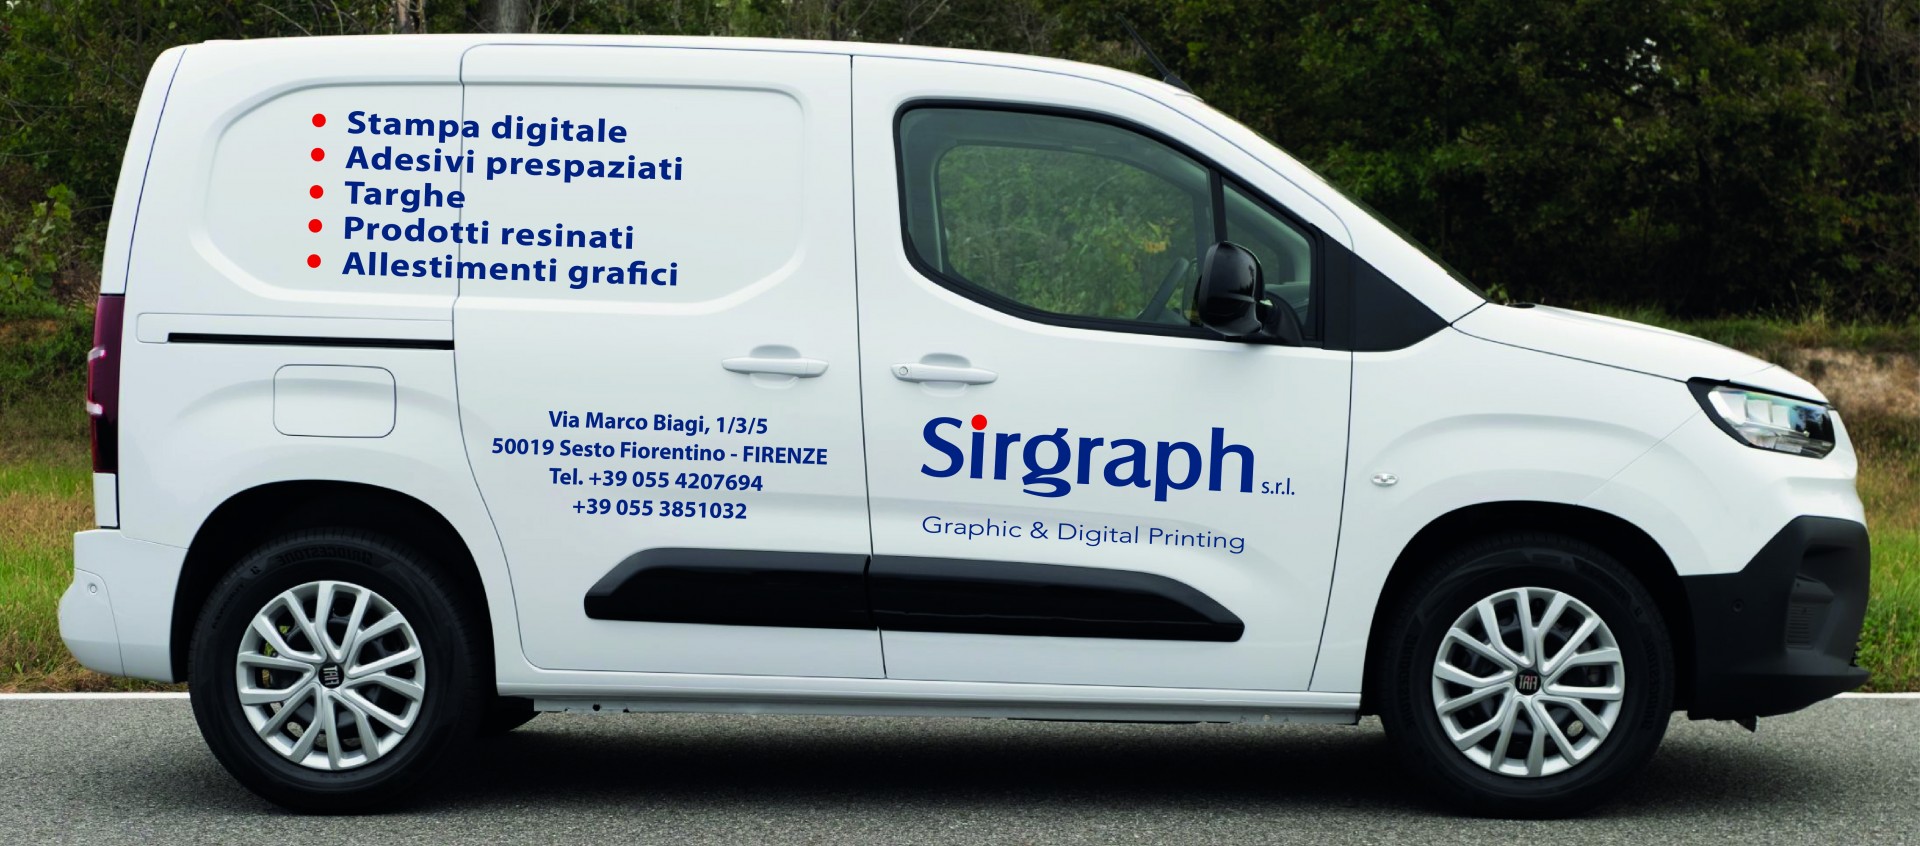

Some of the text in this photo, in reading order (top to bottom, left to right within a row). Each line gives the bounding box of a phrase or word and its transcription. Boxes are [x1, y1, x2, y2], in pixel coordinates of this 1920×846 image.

[348, 111, 627, 146] Stampa digitale
[346, 146, 682, 183] Adesivi prespaziati
[345, 181, 465, 213] Targhe
[345, 217, 633, 249] Prodotti resinati
[342, 252, 677, 289] Allestimenti grafici
[549, 411, 767, 437] Via Marco Biagi, 1/3/5
[492, 438, 554, 456] 50019
[560, 440, 615, 458] Sesto
[621, 442, 725, 462] Fiorentino
[743, 446, 827, 465] FIRENZE
[920, 413, 1295, 502] Sirgraph s.r.l.
[550, 468, 763, 491] Tel. +39 055 4207694
[573, 498, 746, 519] +39 055 3851032
[922, 516, 1245, 554] Graphic & Digital Printing
